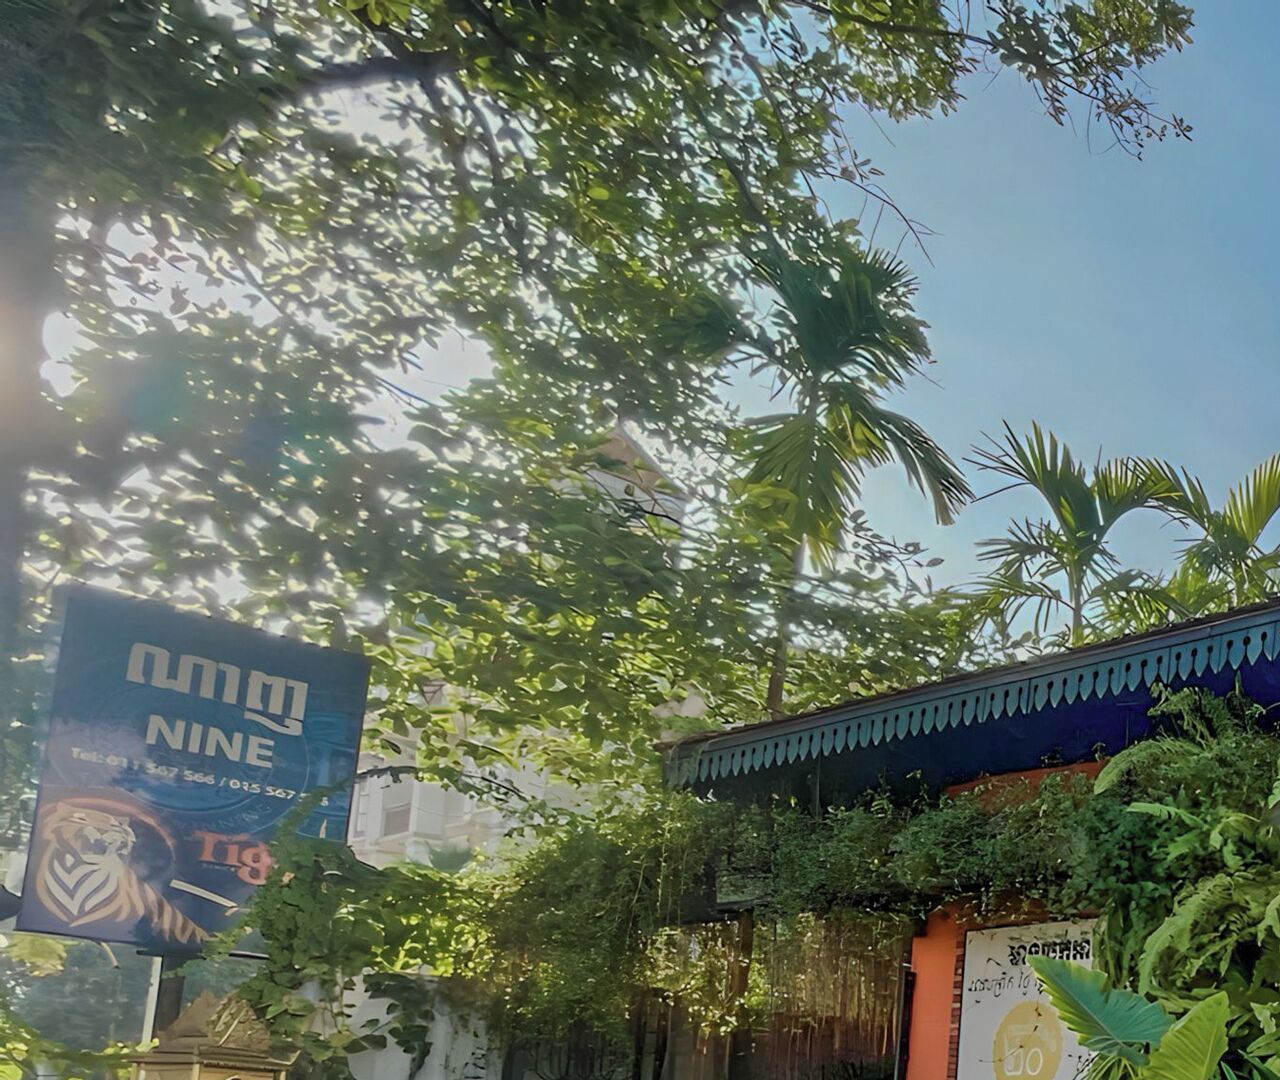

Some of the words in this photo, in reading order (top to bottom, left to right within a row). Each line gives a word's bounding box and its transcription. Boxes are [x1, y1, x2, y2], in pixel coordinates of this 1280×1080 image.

[146, 714, 275, 768] NINE
[183, 768, 215, 786] 566
[264, 786, 297, 800] 567
[192, 831, 273, 887] Tig
